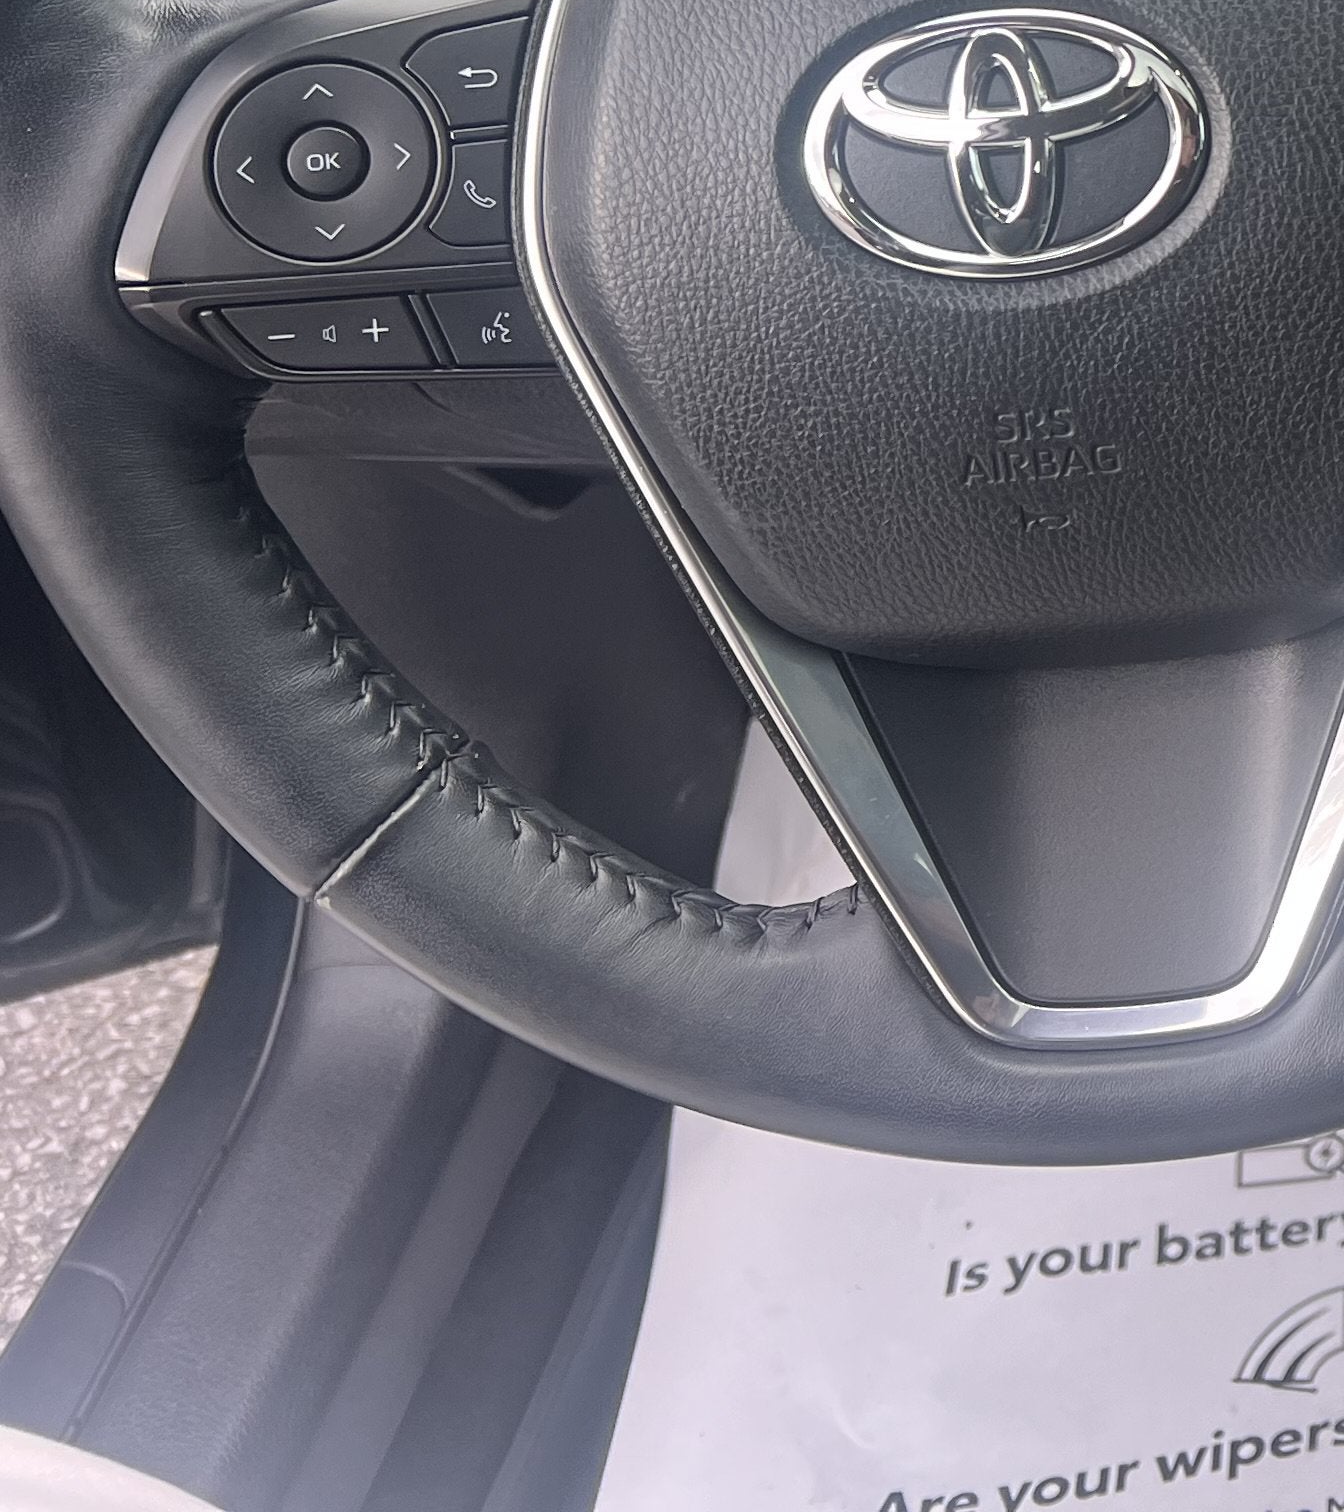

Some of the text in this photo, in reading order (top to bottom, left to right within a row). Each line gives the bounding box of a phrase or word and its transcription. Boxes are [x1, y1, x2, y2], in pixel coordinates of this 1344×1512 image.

[306, 152, 341, 172] OK
[997, 408, 1076, 444] SRS
[964, 444, 1124, 487] AIRBAG
[944, 1257, 989, 1297] Is
[1003, 1234, 1142, 1296] your
[998, 1460, 1139, 1512] your
